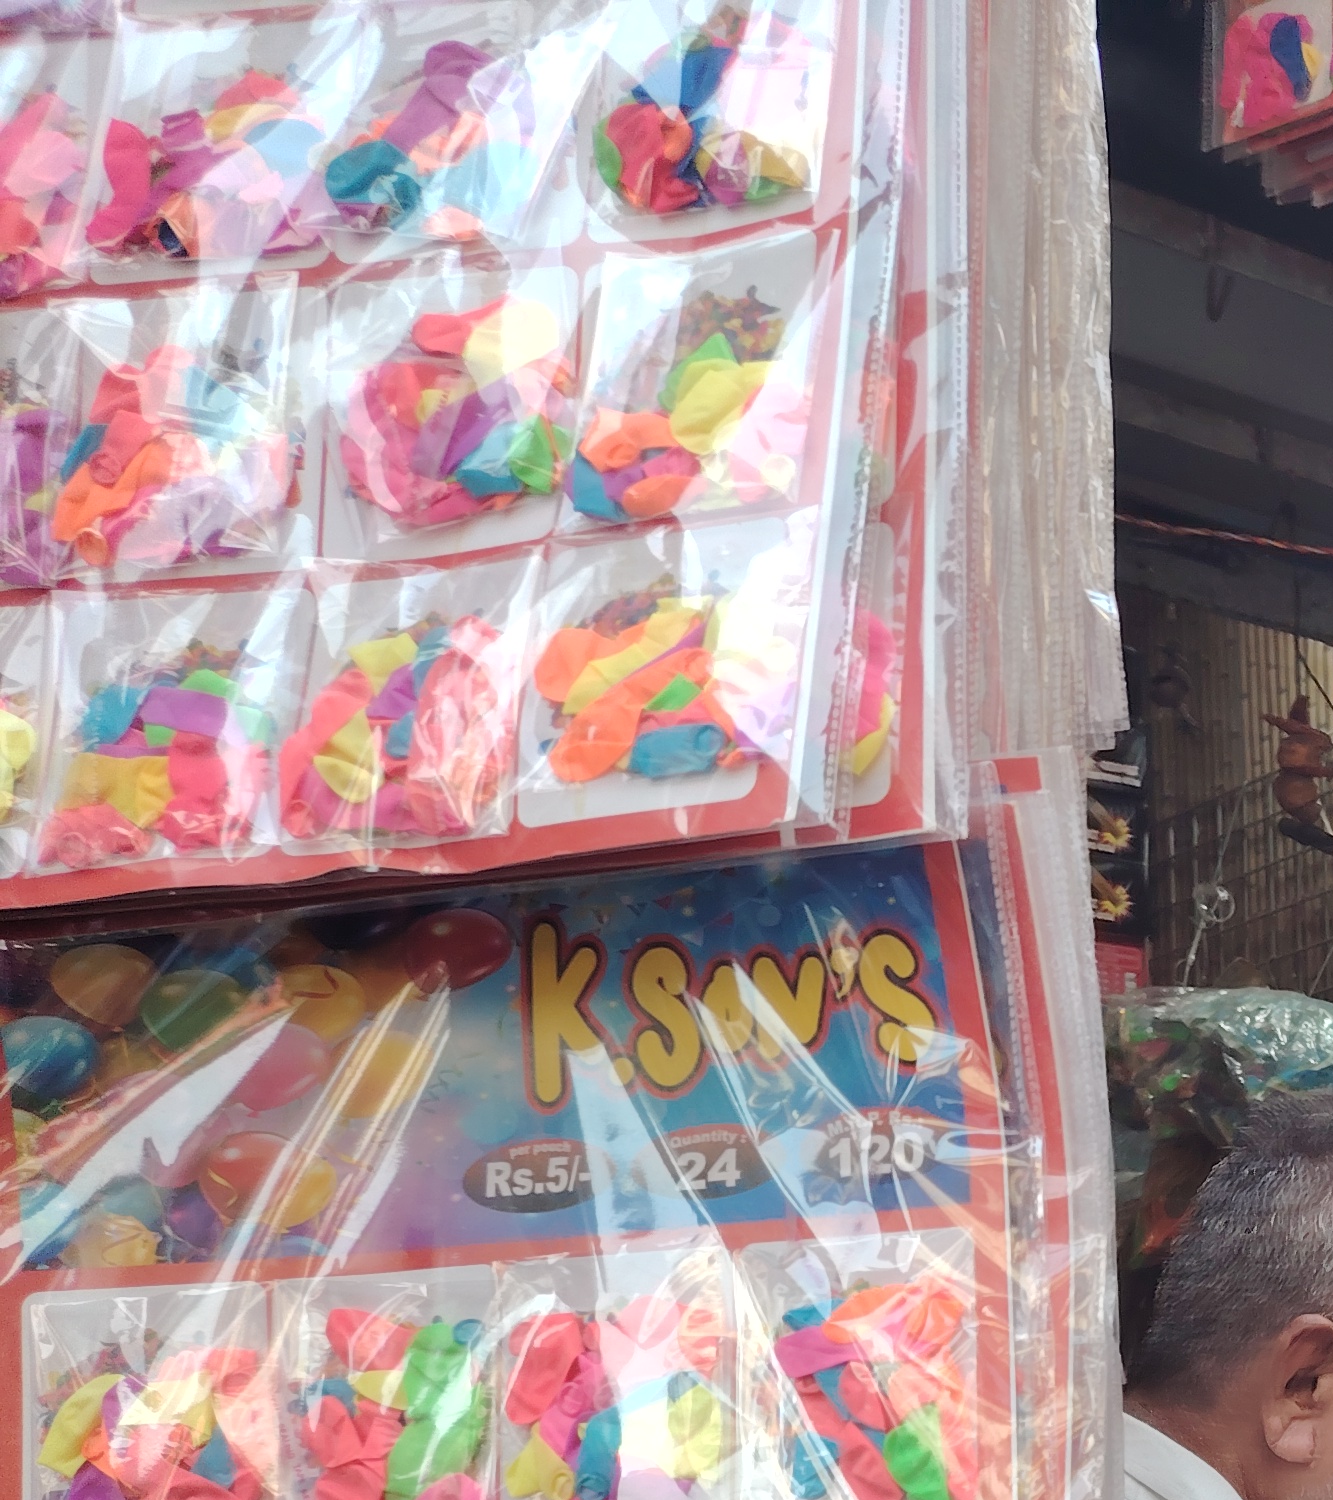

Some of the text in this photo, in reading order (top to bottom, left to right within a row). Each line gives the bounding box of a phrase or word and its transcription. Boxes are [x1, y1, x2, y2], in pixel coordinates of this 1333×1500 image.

[509, 1140, 572, 1160] per pouch
[676, 1148, 742, 1192] 24
[829, 1131, 925, 1178] 120
[485, 1154, 592, 1199] Rs.5/-
